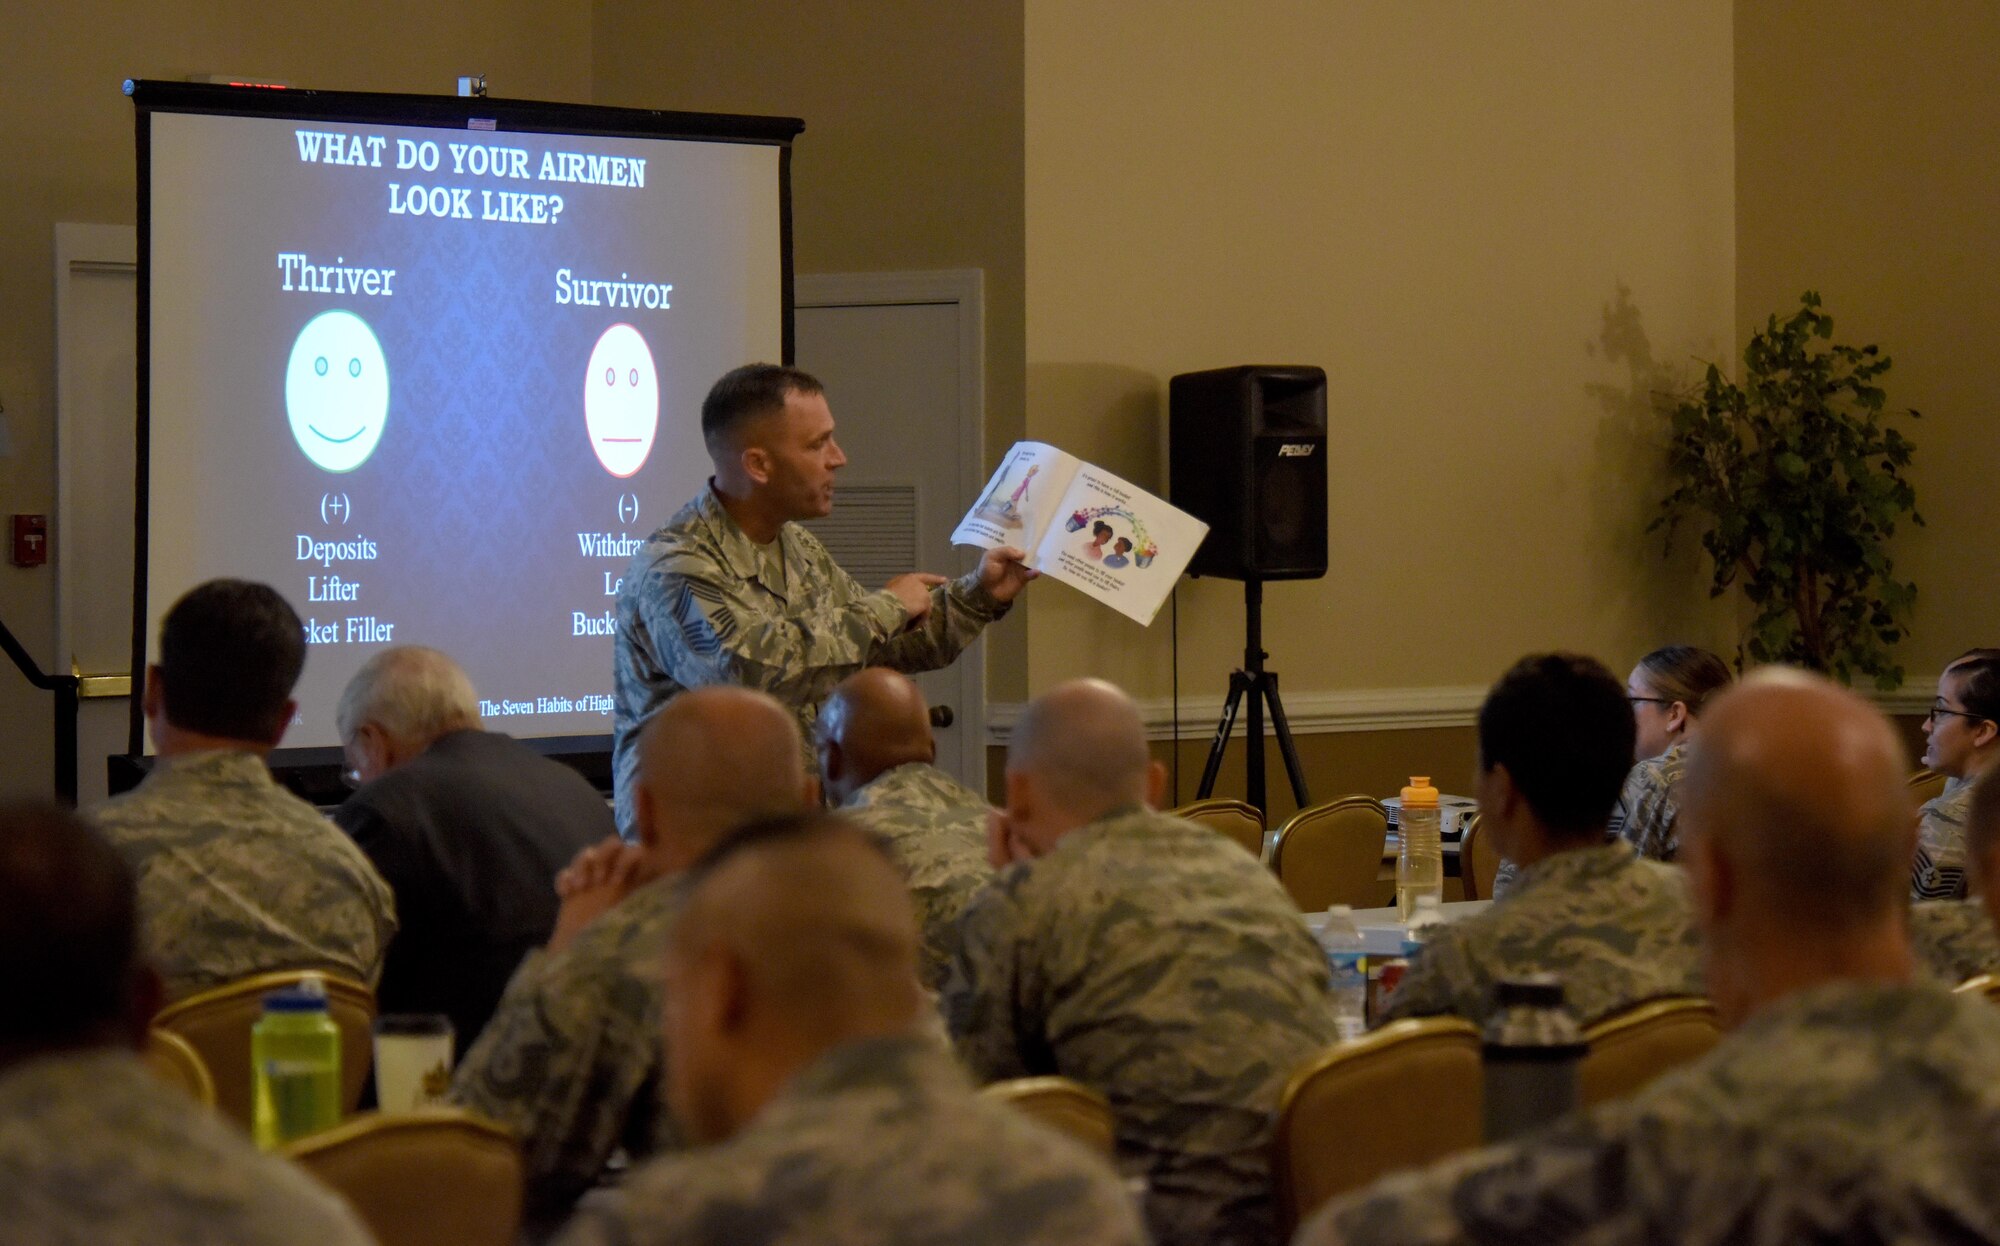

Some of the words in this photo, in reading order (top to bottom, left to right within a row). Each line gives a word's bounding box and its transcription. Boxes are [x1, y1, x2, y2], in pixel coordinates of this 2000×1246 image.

[295, 130, 387, 168] WHAT
[396, 138, 440, 172] DO
[448, 143, 531, 180] YOUR
[537, 151, 647, 188] AIRMEN
[388, 183, 473, 220] LOOK
[481, 190, 564, 225] LIKE?
[277, 253, 396, 296] Thriver
[555, 268, 673, 310] Survivor
[296, 533, 378, 568] Deposits
[577, 532, 645, 557] Withdra
[308, 575, 361, 602] Lifter
[346, 616, 395, 643] Filler
[572, 610, 618, 637] Buck
[479, 699, 500, 717] The
[502, 699, 534, 716] Seven
[536, 696, 573, 714] Habits
[575, 694, 588, 712] of
[588, 694, 614, 716] High
